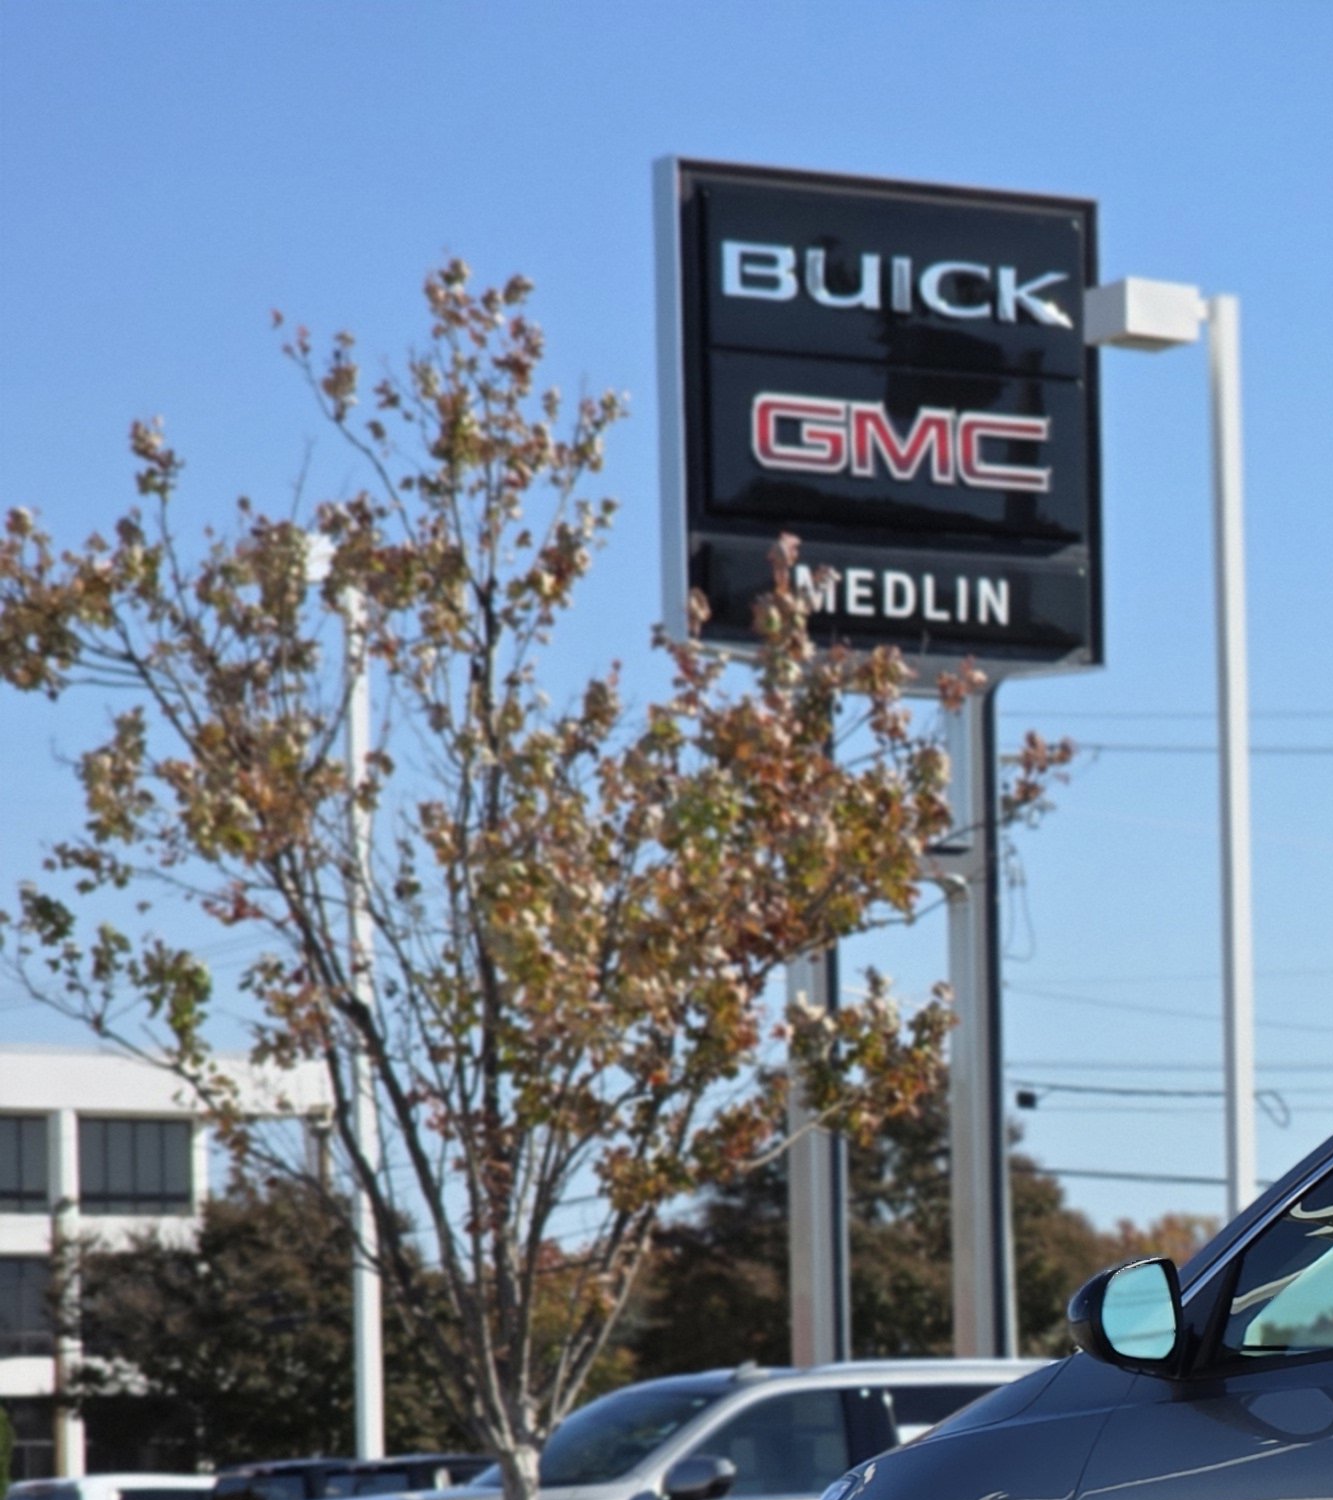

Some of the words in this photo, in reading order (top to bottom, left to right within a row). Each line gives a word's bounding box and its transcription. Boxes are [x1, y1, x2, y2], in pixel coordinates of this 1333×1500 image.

[721, 239, 1074, 329] BUICK
[751, 391, 1052, 494] GMC
[795, 564, 1010, 626] MEDLIN
